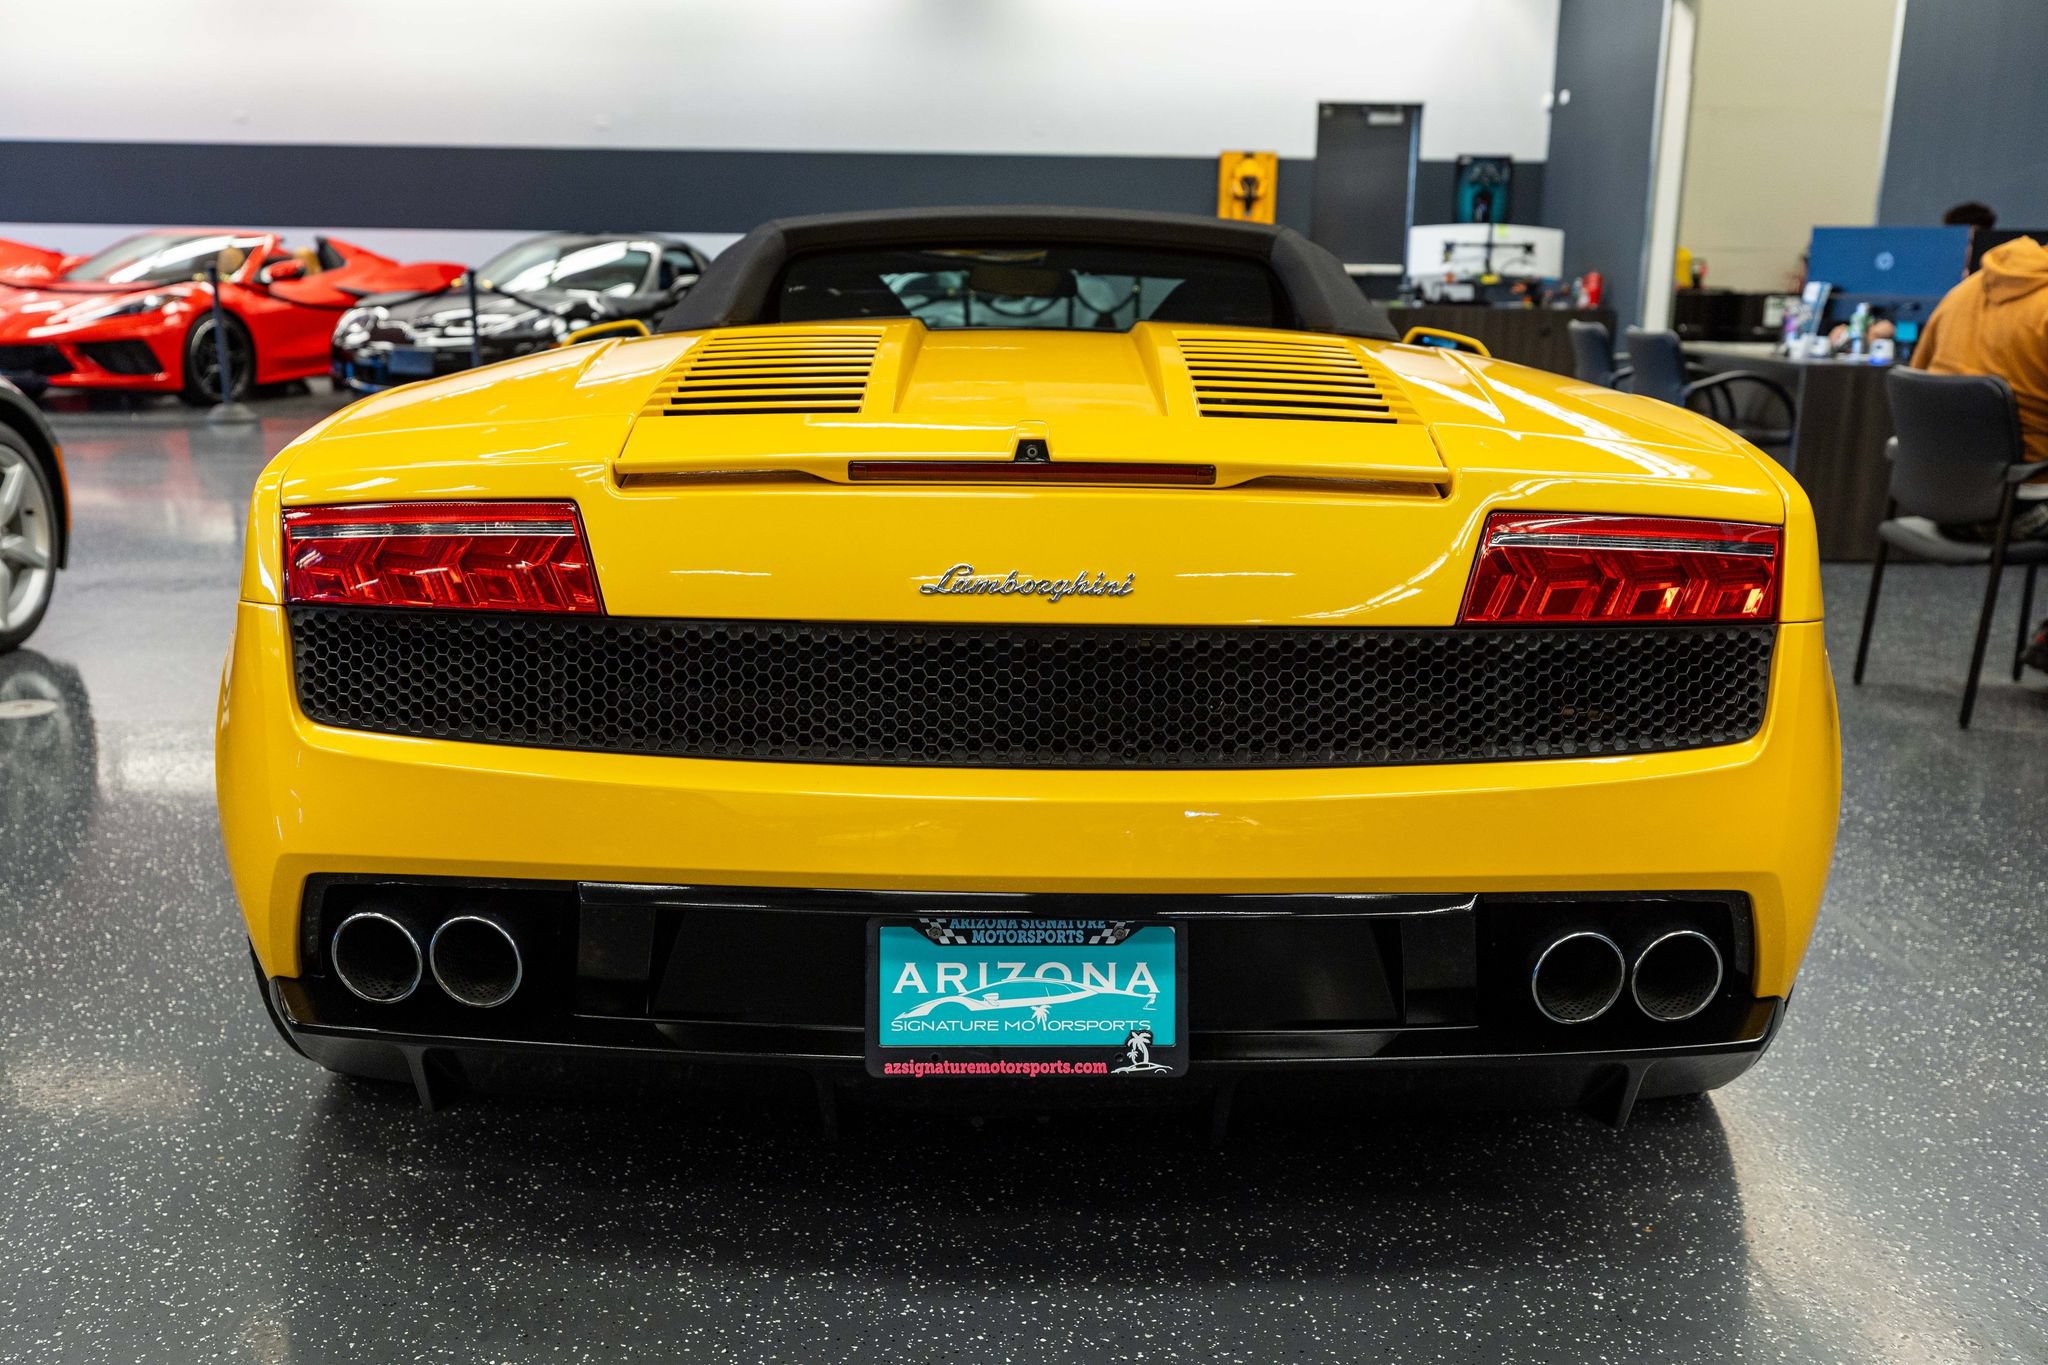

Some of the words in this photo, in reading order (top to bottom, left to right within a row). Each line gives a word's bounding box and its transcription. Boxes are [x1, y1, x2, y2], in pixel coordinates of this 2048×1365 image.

[920, 563, 1136, 603] Lamborghini
[950, 918, 1018, 929] ARIZONA
[1021, 918, 1106, 929] SIGNATURE
[971, 929, 1084, 944] MOTORSPORTS
[892, 962, 1160, 994] ARIZONA
[891, 1020, 999, 1031] SIGNATURE
[884, 1059, 1107, 1078] azsignaturemotorsports.com
